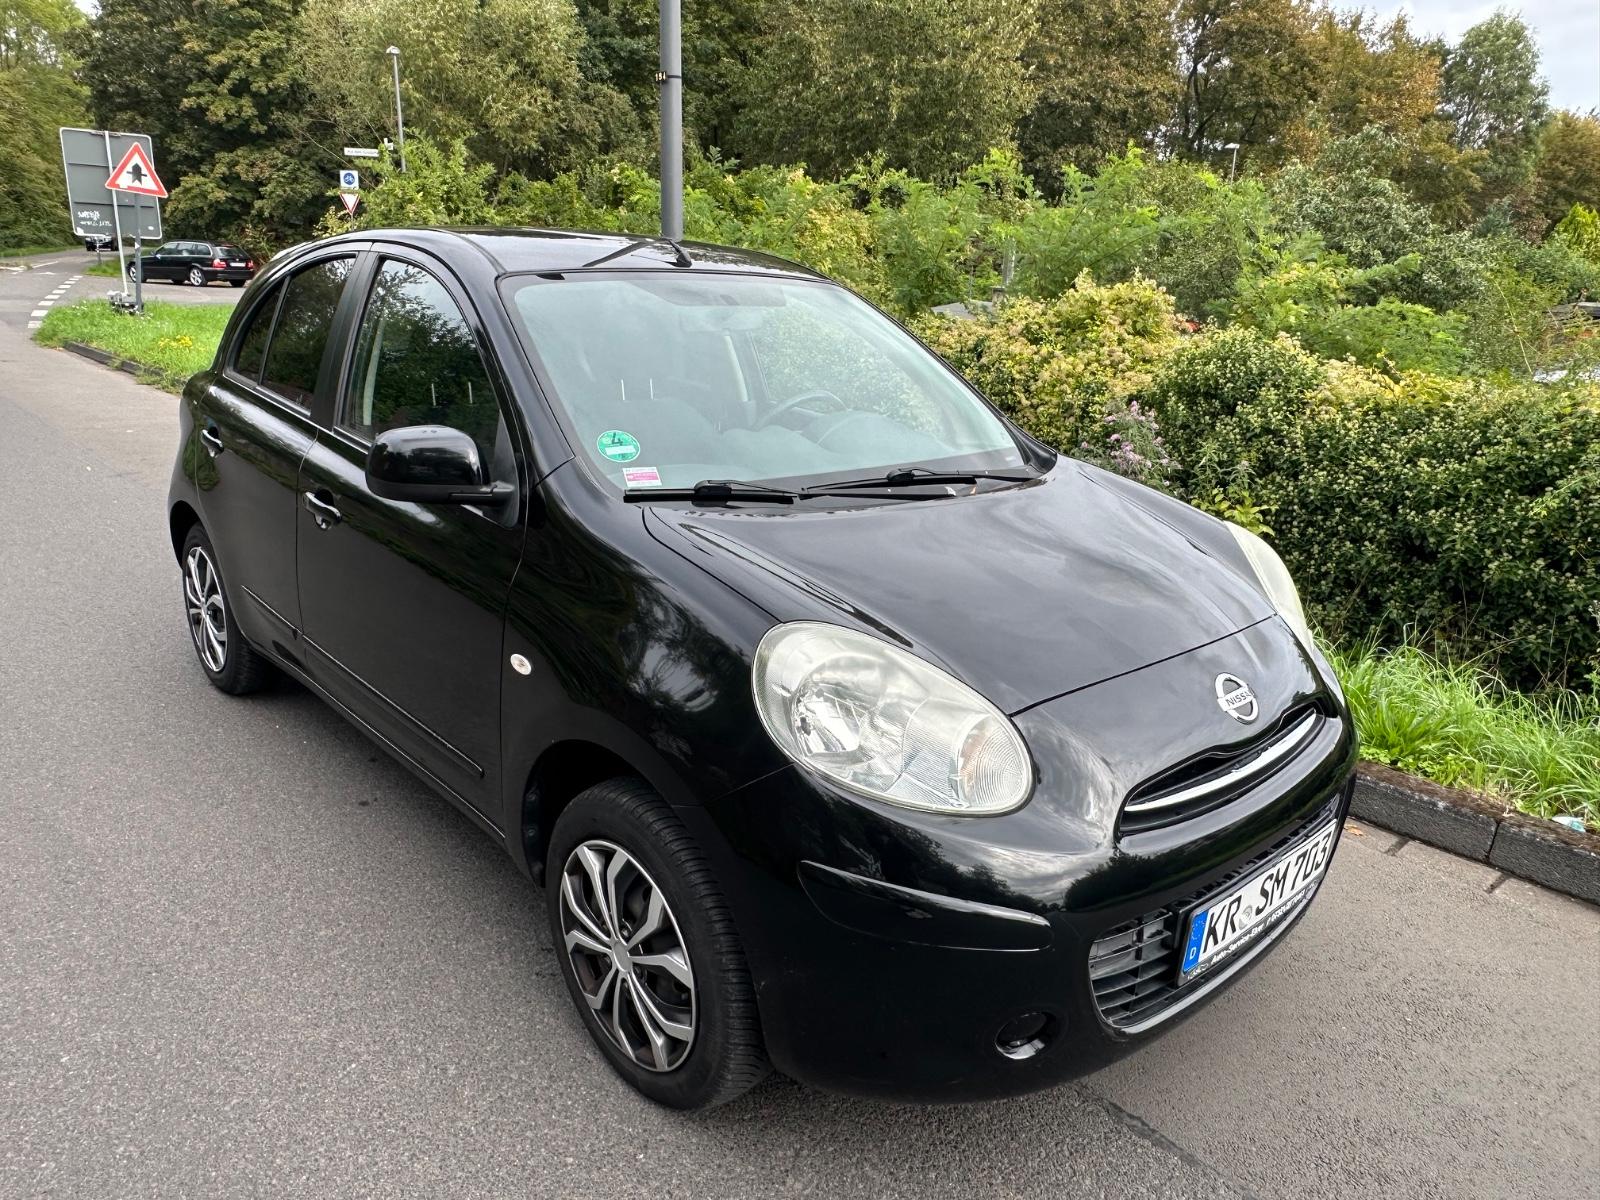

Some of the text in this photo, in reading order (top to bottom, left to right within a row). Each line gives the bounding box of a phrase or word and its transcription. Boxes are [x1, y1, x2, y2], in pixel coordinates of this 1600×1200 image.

[611, 432, 624, 446] 4
[1203, 895, 1242, 954] KR
[1255, 861, 1291, 916] SM
[1291, 830, 1332, 891] 703
[1189, 947, 1197, 960] D
